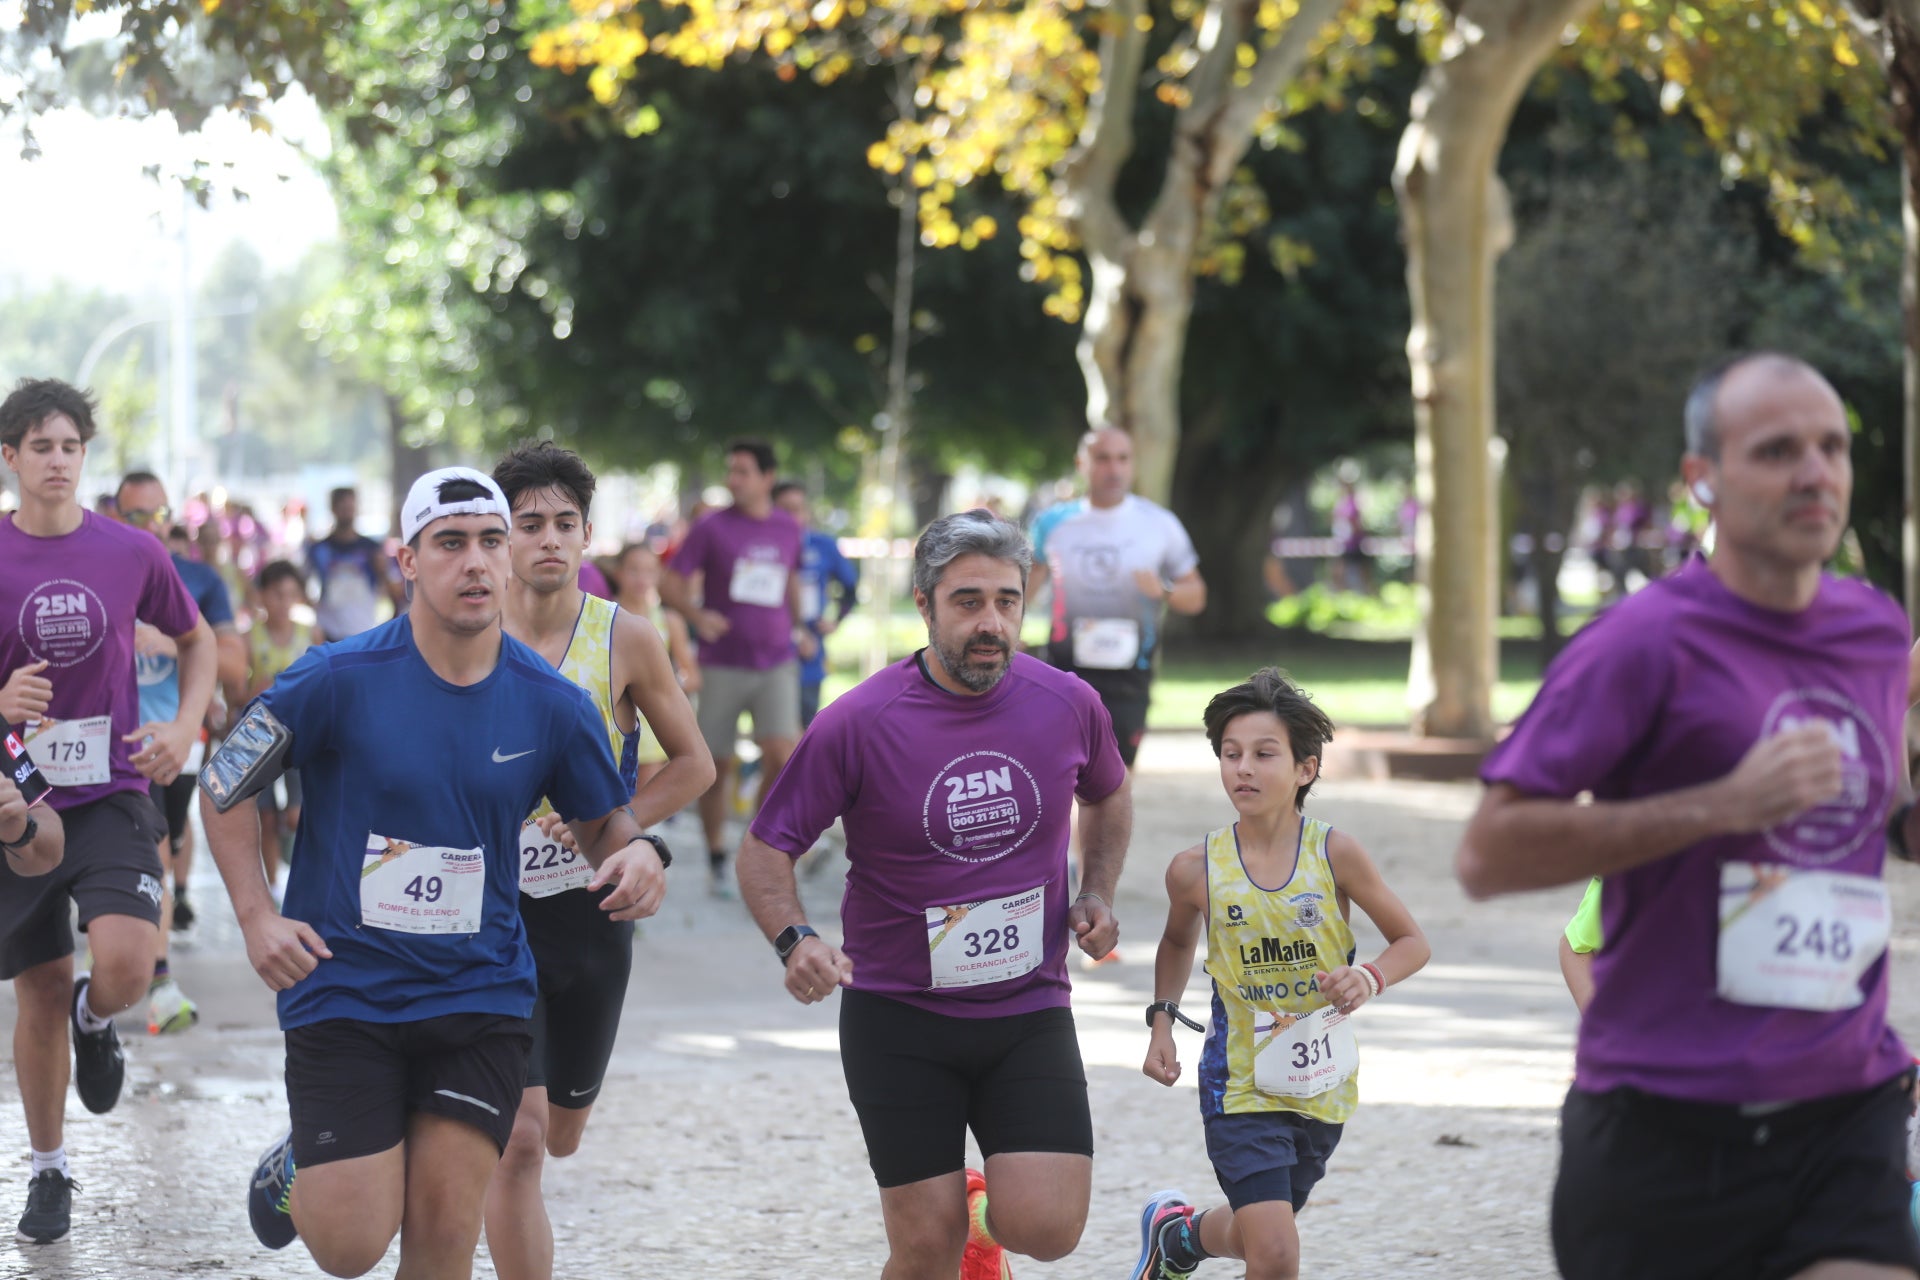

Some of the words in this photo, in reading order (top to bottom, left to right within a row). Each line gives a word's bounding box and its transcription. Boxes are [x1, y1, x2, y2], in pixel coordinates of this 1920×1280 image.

[34, 593, 87, 616] 25N
[48, 741, 86, 762] 179
[923, 770, 945, 816] INTERNACIONAL
[944, 755, 966, 771] CONTRA
[975, 750, 1007, 760] VIOLENCIA
[1007, 756, 1024, 771] HACIA
[1023, 768, 1033, 780] LAS
[944, 766, 1013, 804] 25N
[953, 815, 975, 827] 900
[976, 812, 987, 823] 21
[988, 810, 1000, 820] 21
[1001, 807, 1015, 817] 30
[944, 850, 968, 863] CONTRA
[979, 847, 1015, 863] VIOLENCIA
[1014, 820, 1039, 848] MACHISTA
[441, 852, 482, 862] CARRERA
[523, 844, 577, 872] 225
[522, 874, 546, 884] AMOR
[547, 872, 559, 880] NO
[560, 863, 594, 877] LASTIMA
[404, 875, 443, 902] 49
[378, 902, 408, 914] ROMPE
[410, 908, 422, 916] EL
[423, 908, 461, 916] SILENCIO
[1002, 892, 1041, 910] CARRERA
[964, 925, 1020, 958] 328
[1776, 914, 1852, 962] 248
[955, 957, 1008, 973] TOLERANCIA
[1009, 951, 1030, 964] CERO
[1254, 967, 1280, 975] SIENTA
[1300, 962, 1318, 970] MESA
[1291, 1033, 1332, 1069] 331
[1314, 1064, 1336, 1077] MENOS
